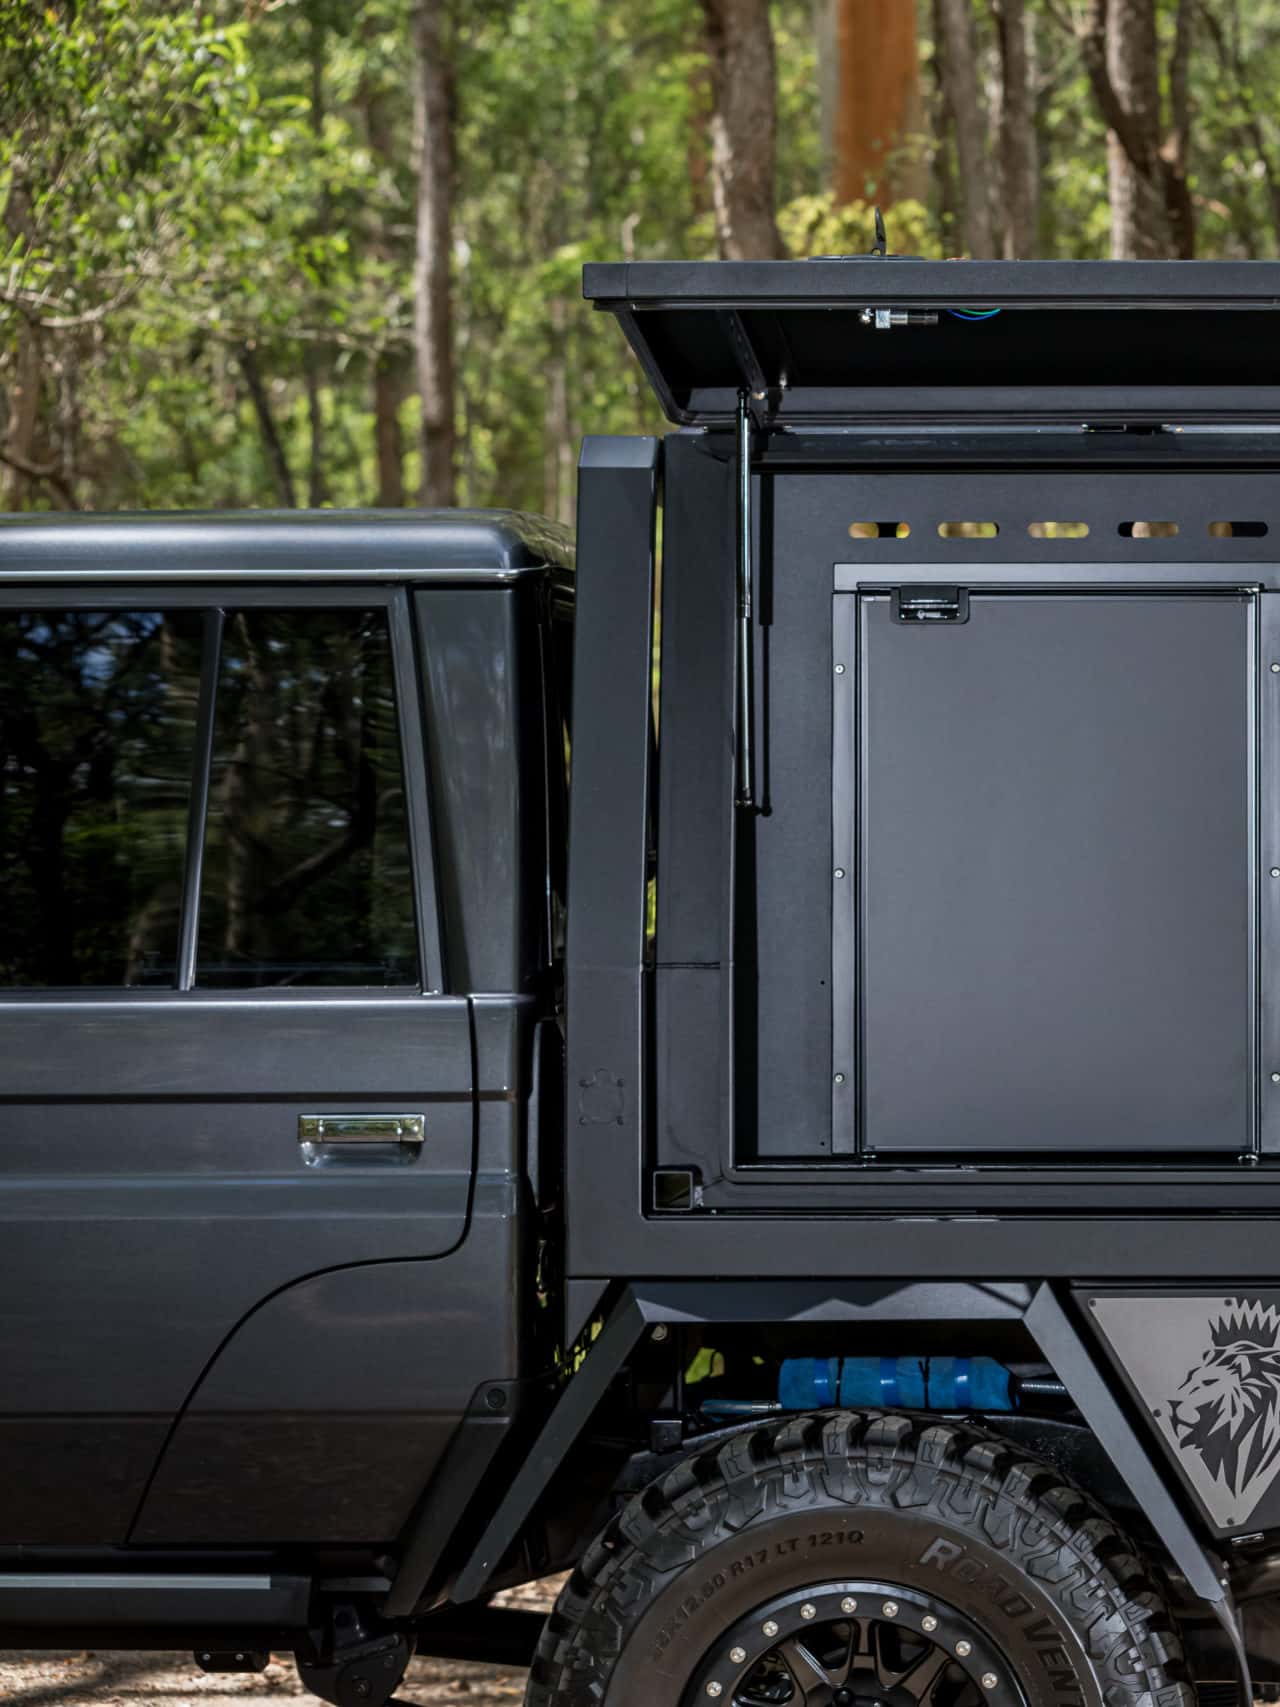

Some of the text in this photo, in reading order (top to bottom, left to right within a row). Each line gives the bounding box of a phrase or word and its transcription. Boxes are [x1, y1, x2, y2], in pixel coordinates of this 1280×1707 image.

[730, 1549, 768, 1576] R17
[776, 1537, 800, 1555] LT
[808, 1529, 864, 1547] 121Q
[919, 1536, 1087, 1707] ROADVEN
